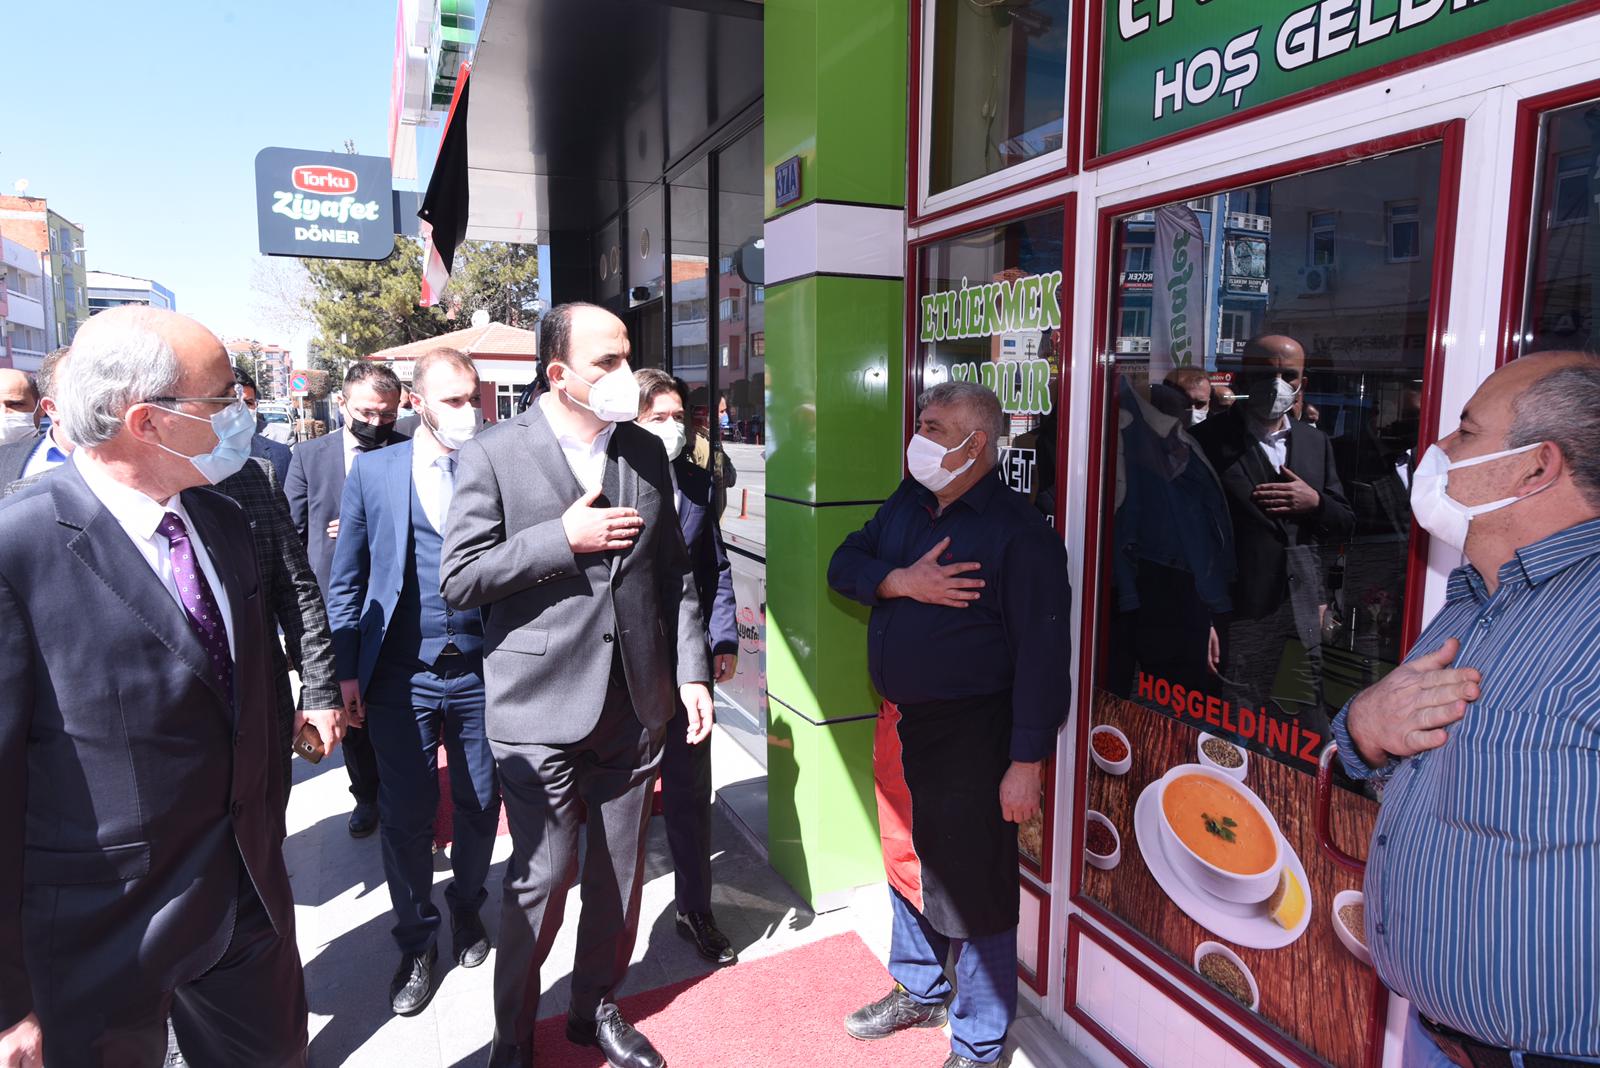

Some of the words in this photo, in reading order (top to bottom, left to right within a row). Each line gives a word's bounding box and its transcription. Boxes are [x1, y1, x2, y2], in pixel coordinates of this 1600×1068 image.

[1153, 26, 1262, 120] HOŞ
[300, 170, 350, 188] Torku
[272, 191, 379, 223] Ziyafet
[295, 224, 359, 244] DÖNER
[920, 270, 1062, 342] ETLİEKMEK
[997, 446, 1036, 493] KET
[1138, 671, 1321, 765] HOŞGELDİNİZ
